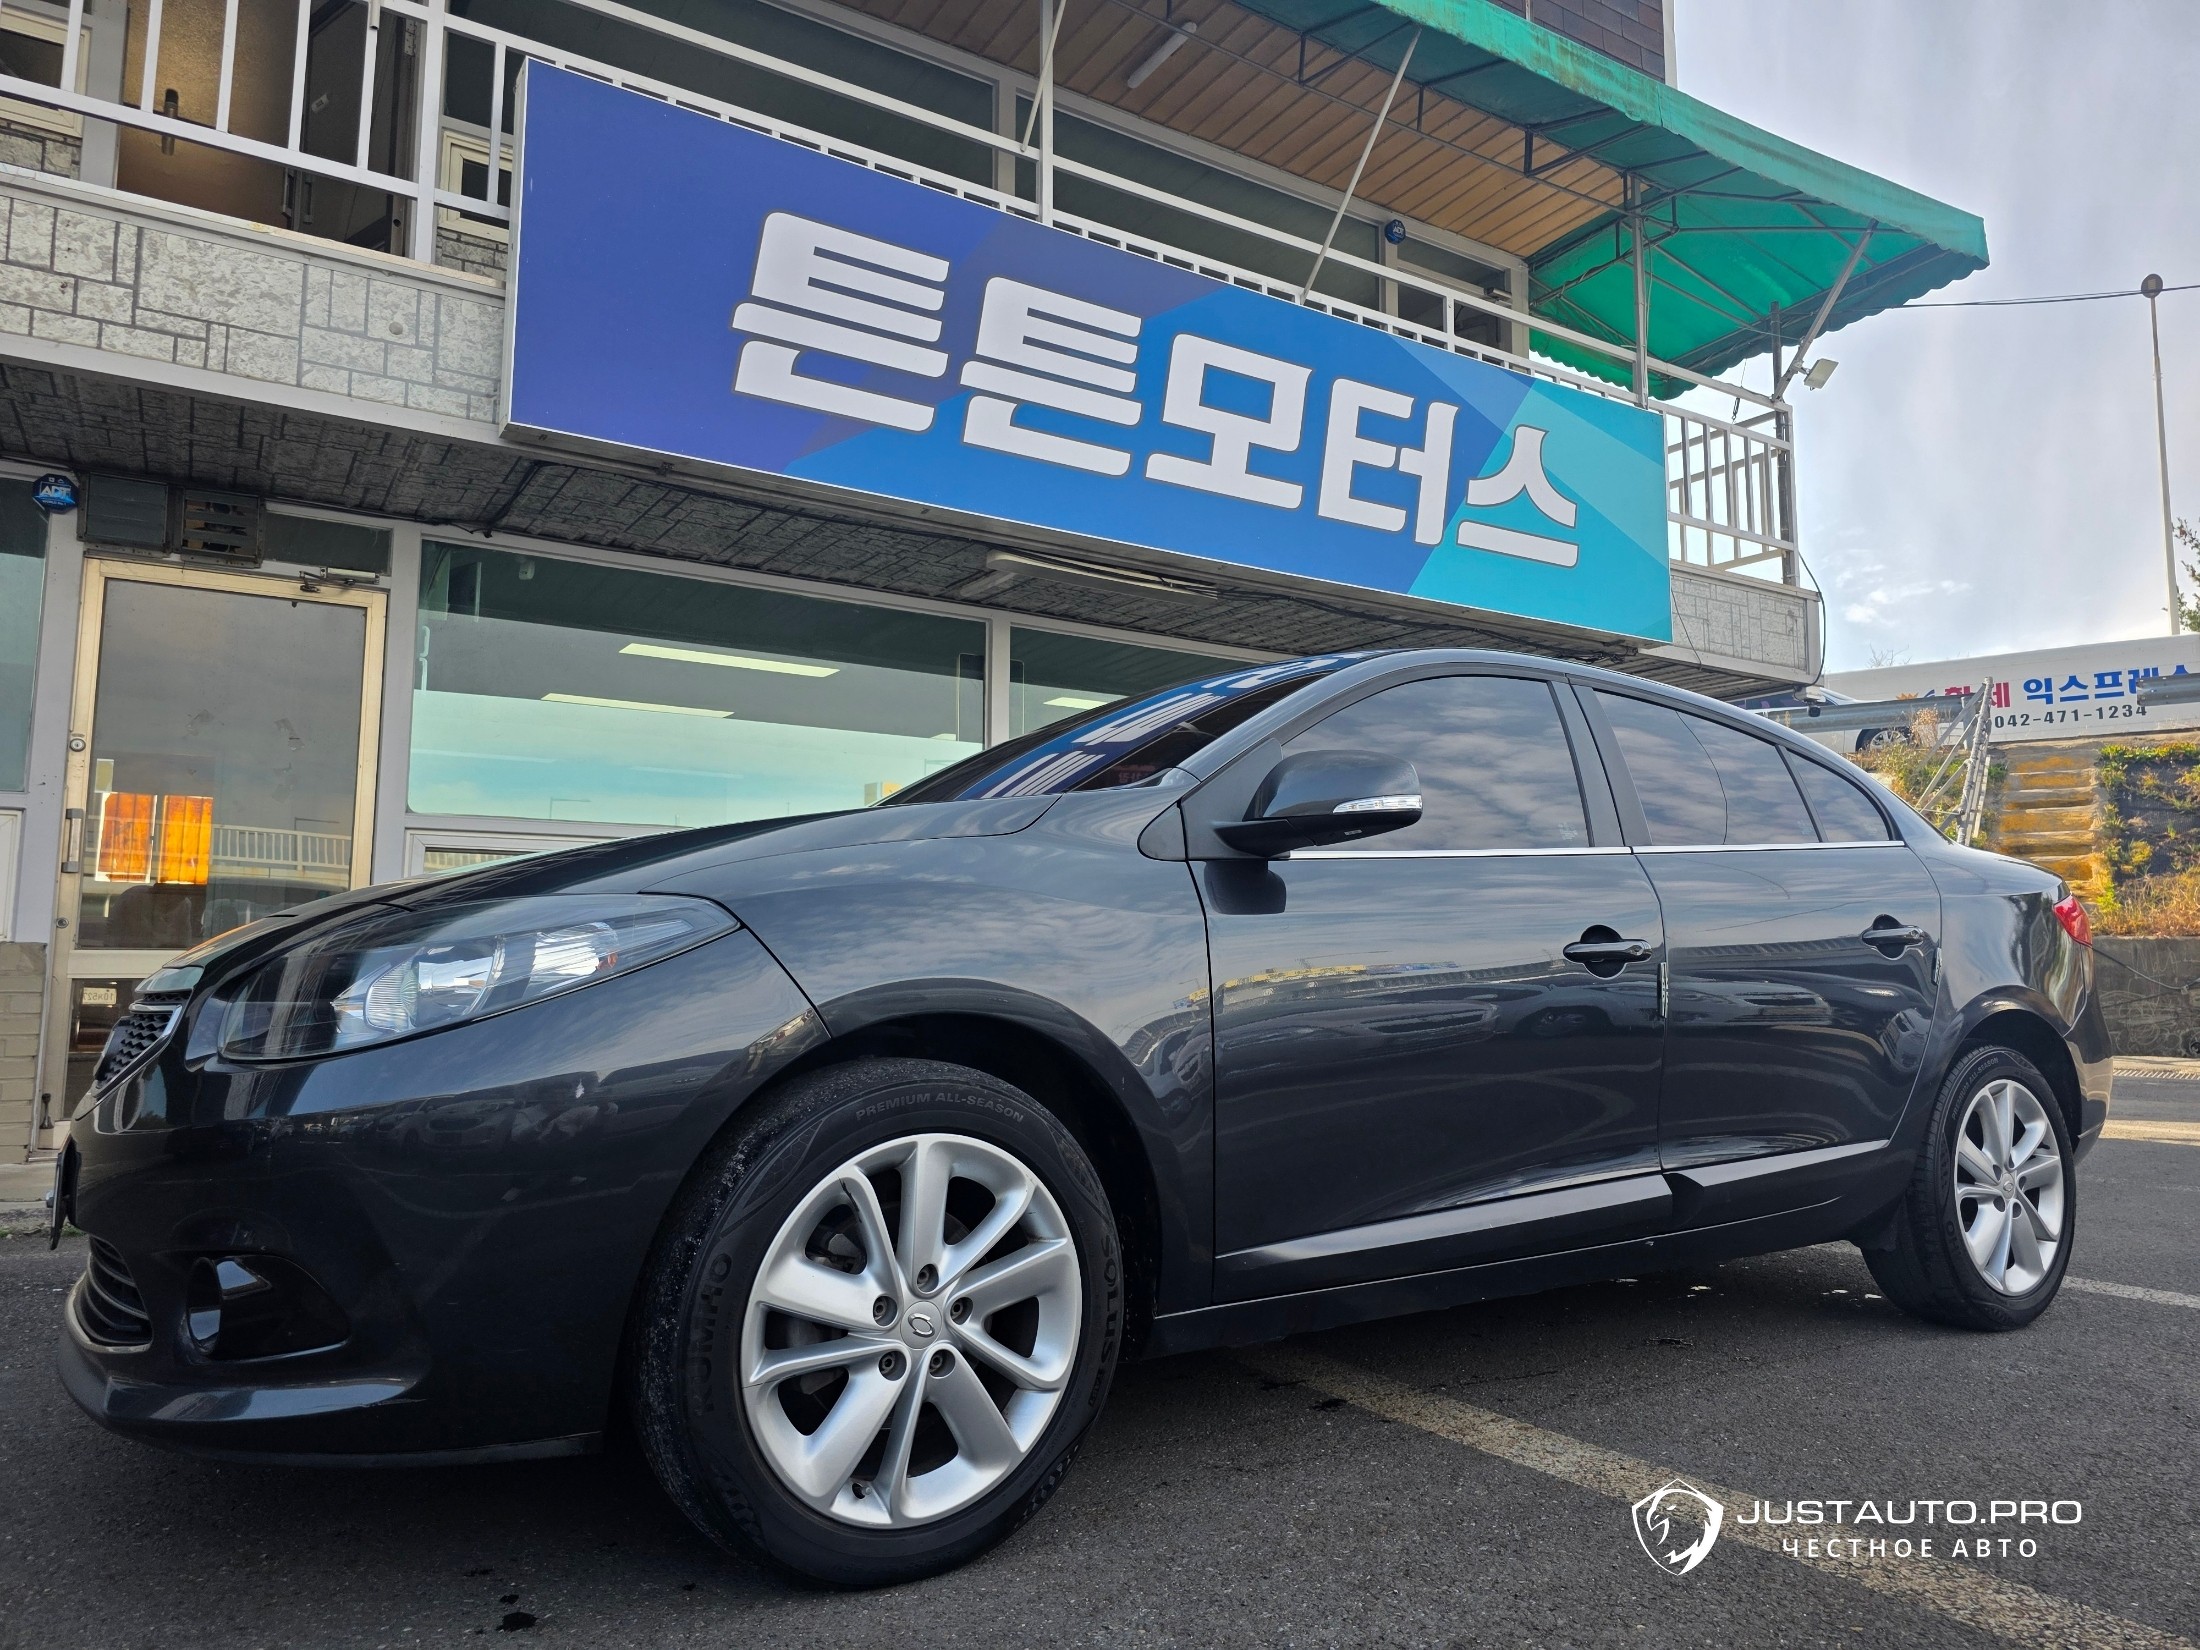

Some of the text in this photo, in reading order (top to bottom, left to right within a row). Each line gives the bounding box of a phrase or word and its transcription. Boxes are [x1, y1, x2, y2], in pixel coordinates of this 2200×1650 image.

[732, 211, 1579, 568] 튼튼모터스
[41, 485, 71, 498] ADT
[2023, 664, 2190, 705] 익스프레
[1994, 704, 2147, 729] 042-471-1234
[856, 1092, 1024, 1123] PREMIUM ALL-SEASON
[1101, 1235, 1119, 1364] SOLUS
[689, 1253, 733, 1416] KUMHO
